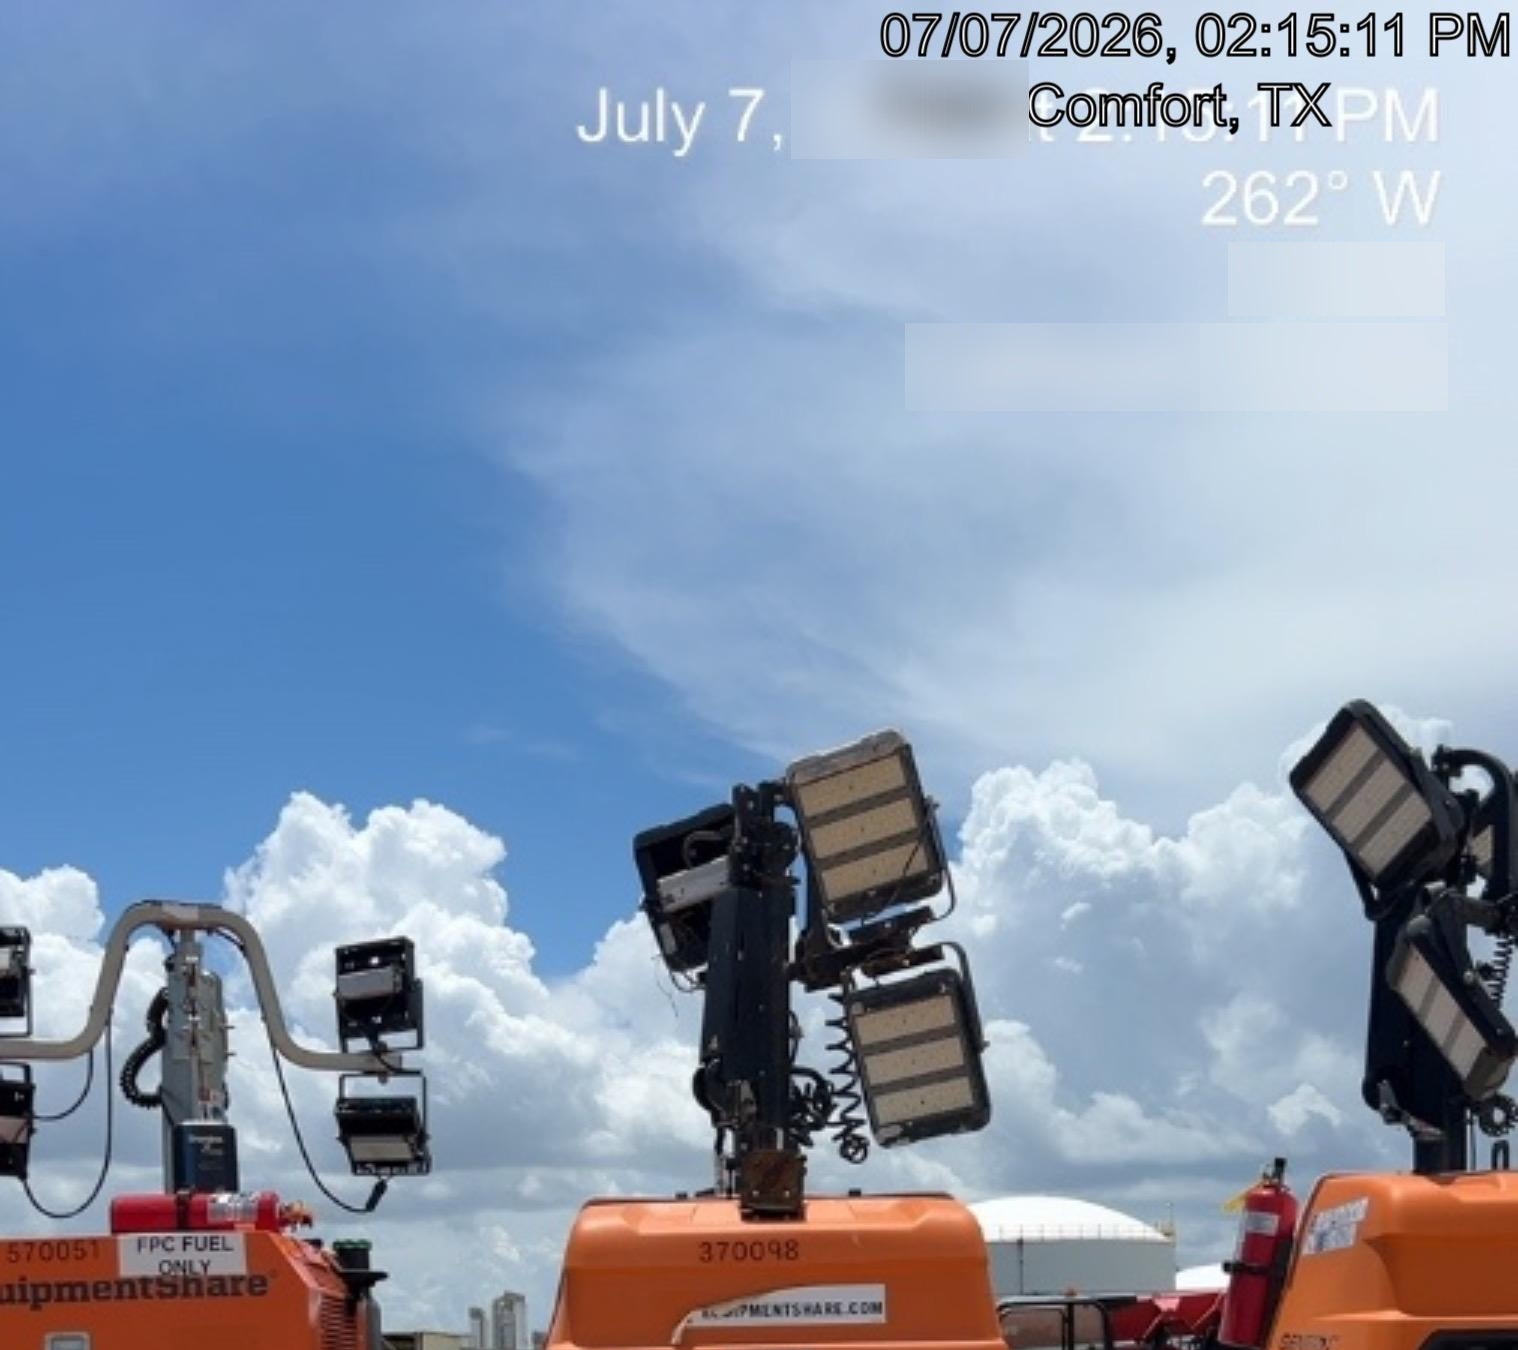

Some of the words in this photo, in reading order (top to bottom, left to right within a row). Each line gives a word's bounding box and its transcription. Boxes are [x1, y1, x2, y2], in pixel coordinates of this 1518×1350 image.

[7, 1241, 100, 1264] 570051
[137, 1236, 175, 1253] FPC
[182, 1236, 234, 1252] FUEL
[700, 1239, 799, 1263] 370098
[159, 1259, 211, 1276] ONLY
